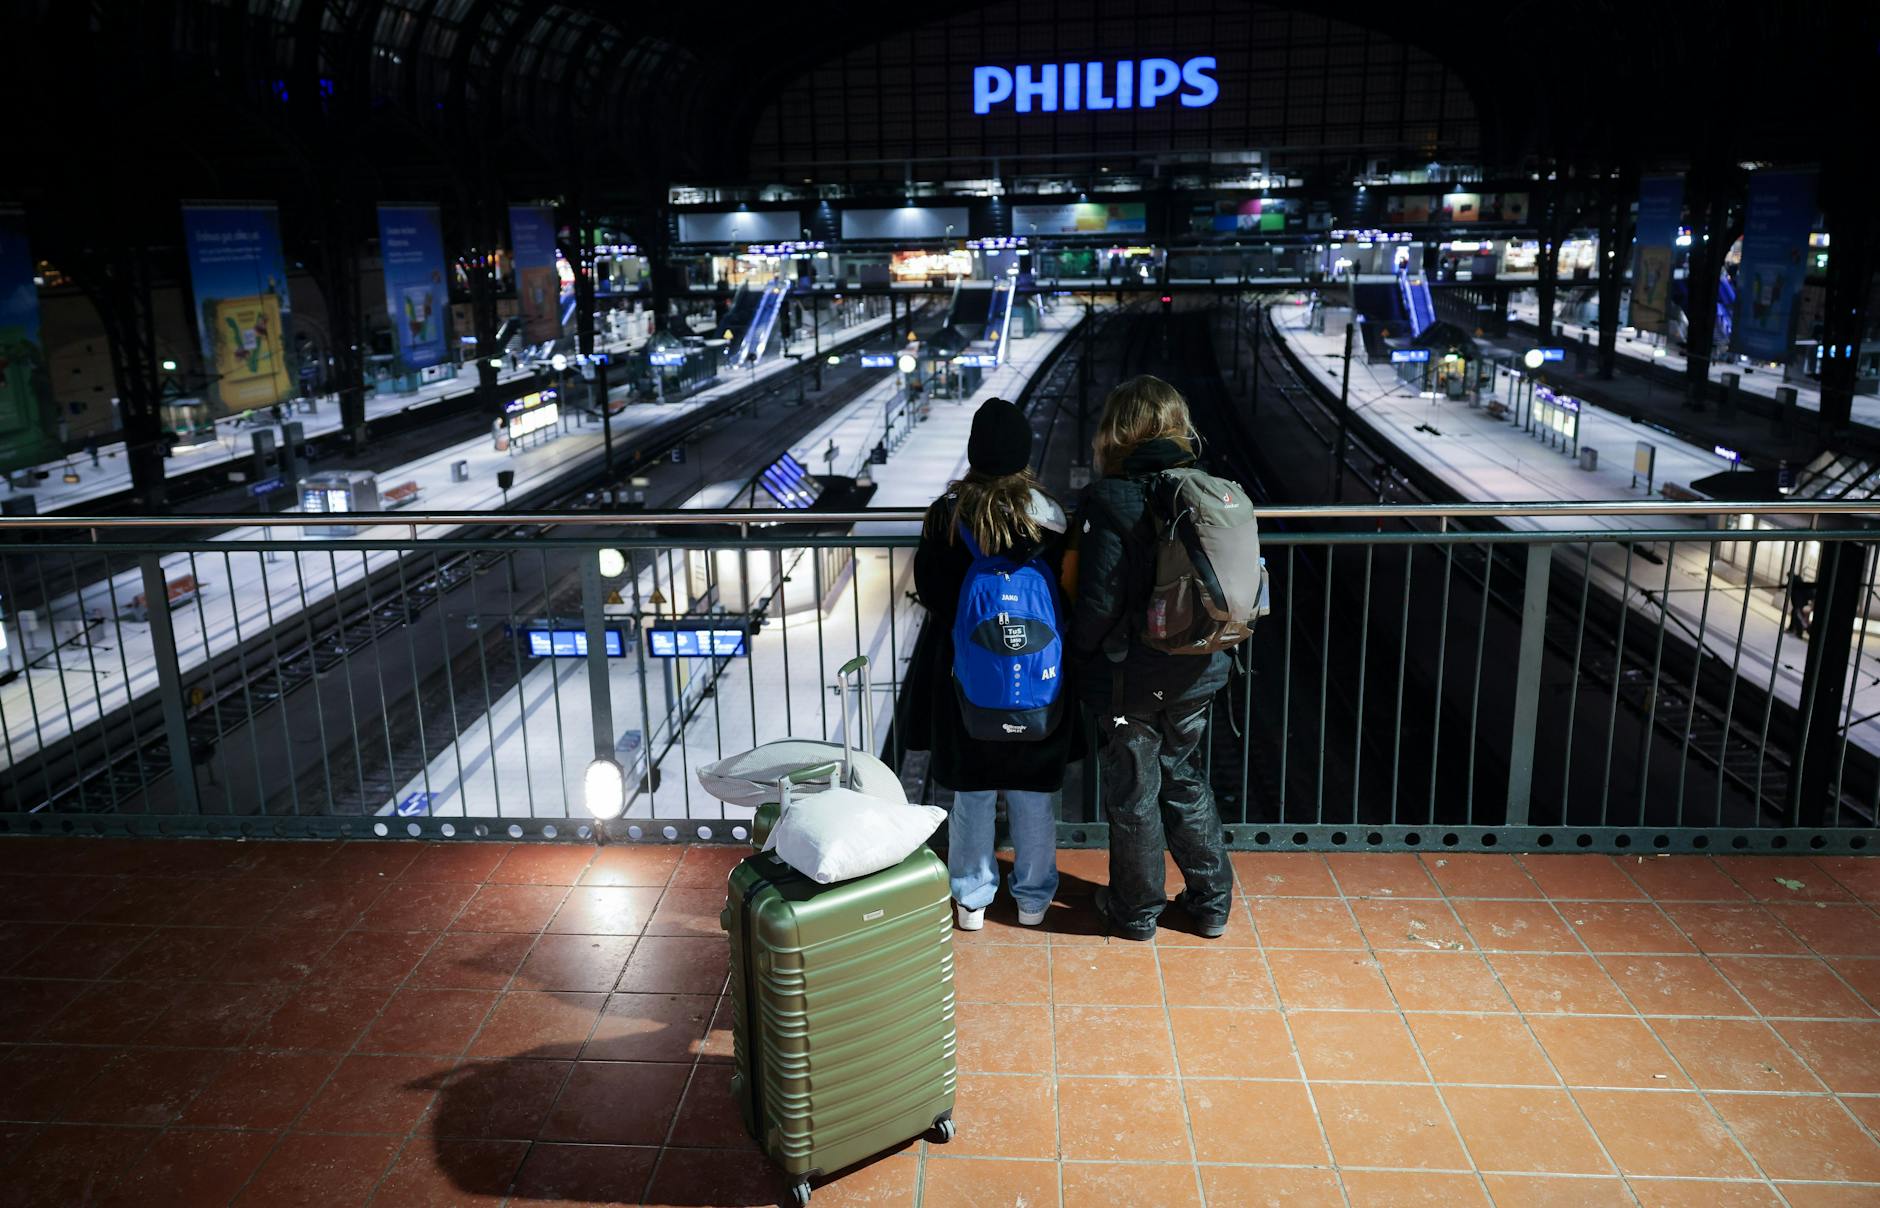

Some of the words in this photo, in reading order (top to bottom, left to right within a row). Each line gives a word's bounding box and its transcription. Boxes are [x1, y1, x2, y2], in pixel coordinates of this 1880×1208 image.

[973, 56, 1219, 114] PHILIPS
[671, 448, 681, 462] E
[1041, 666, 1056, 680] AK
